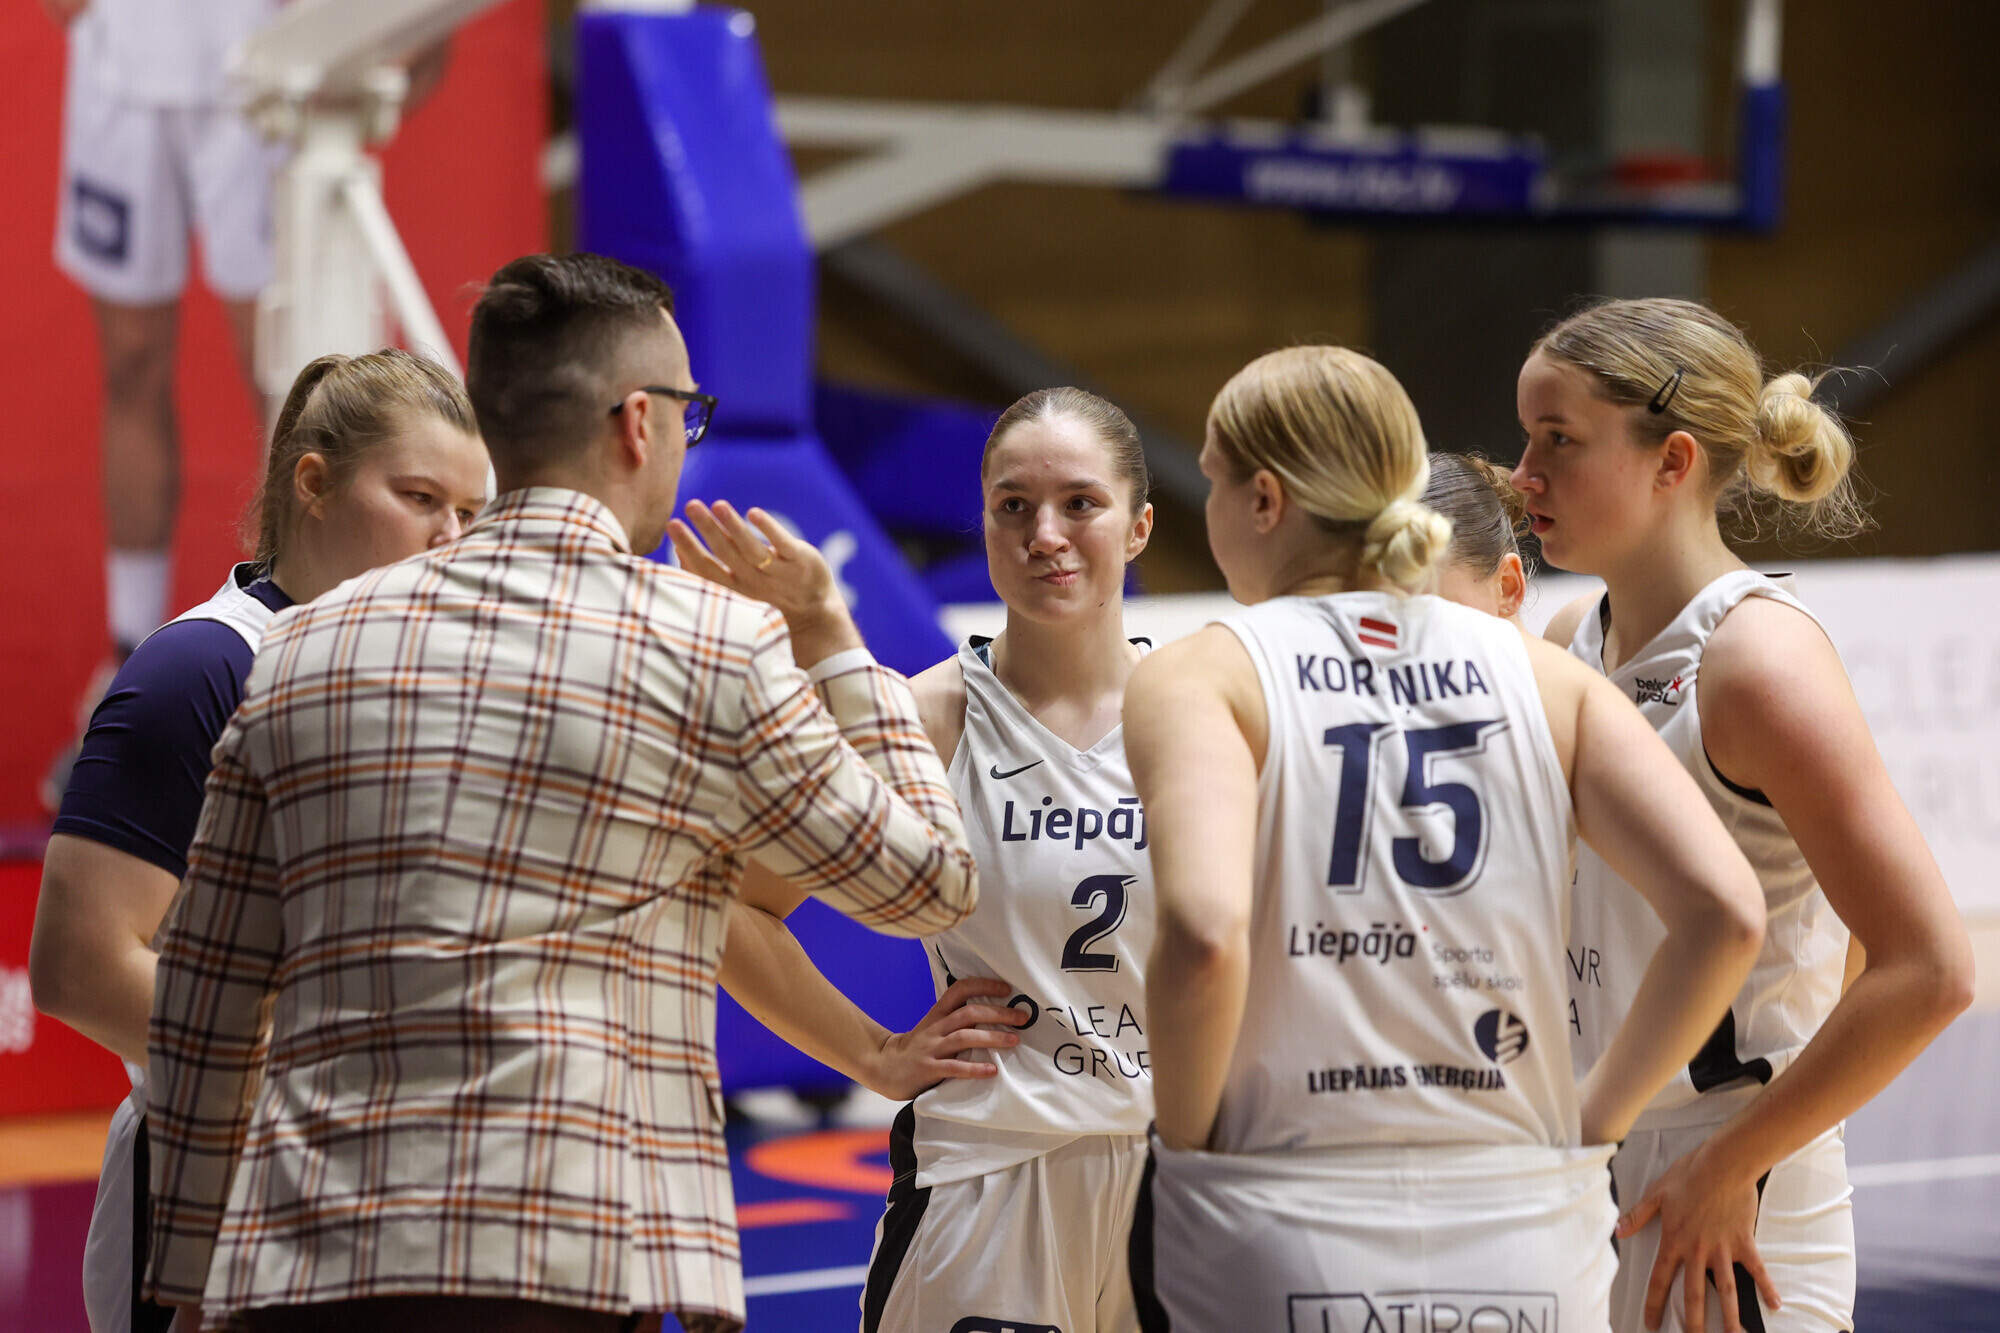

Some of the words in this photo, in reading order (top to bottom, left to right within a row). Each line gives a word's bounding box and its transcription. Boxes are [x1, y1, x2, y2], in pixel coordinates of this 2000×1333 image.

[1323, 719, 1511, 897] 15
[1060, 874, 1139, 973] 2
[1290, 922, 1417, 965] Liepāja
[1308, 1064, 1408, 1094] LIEPĀJAS
